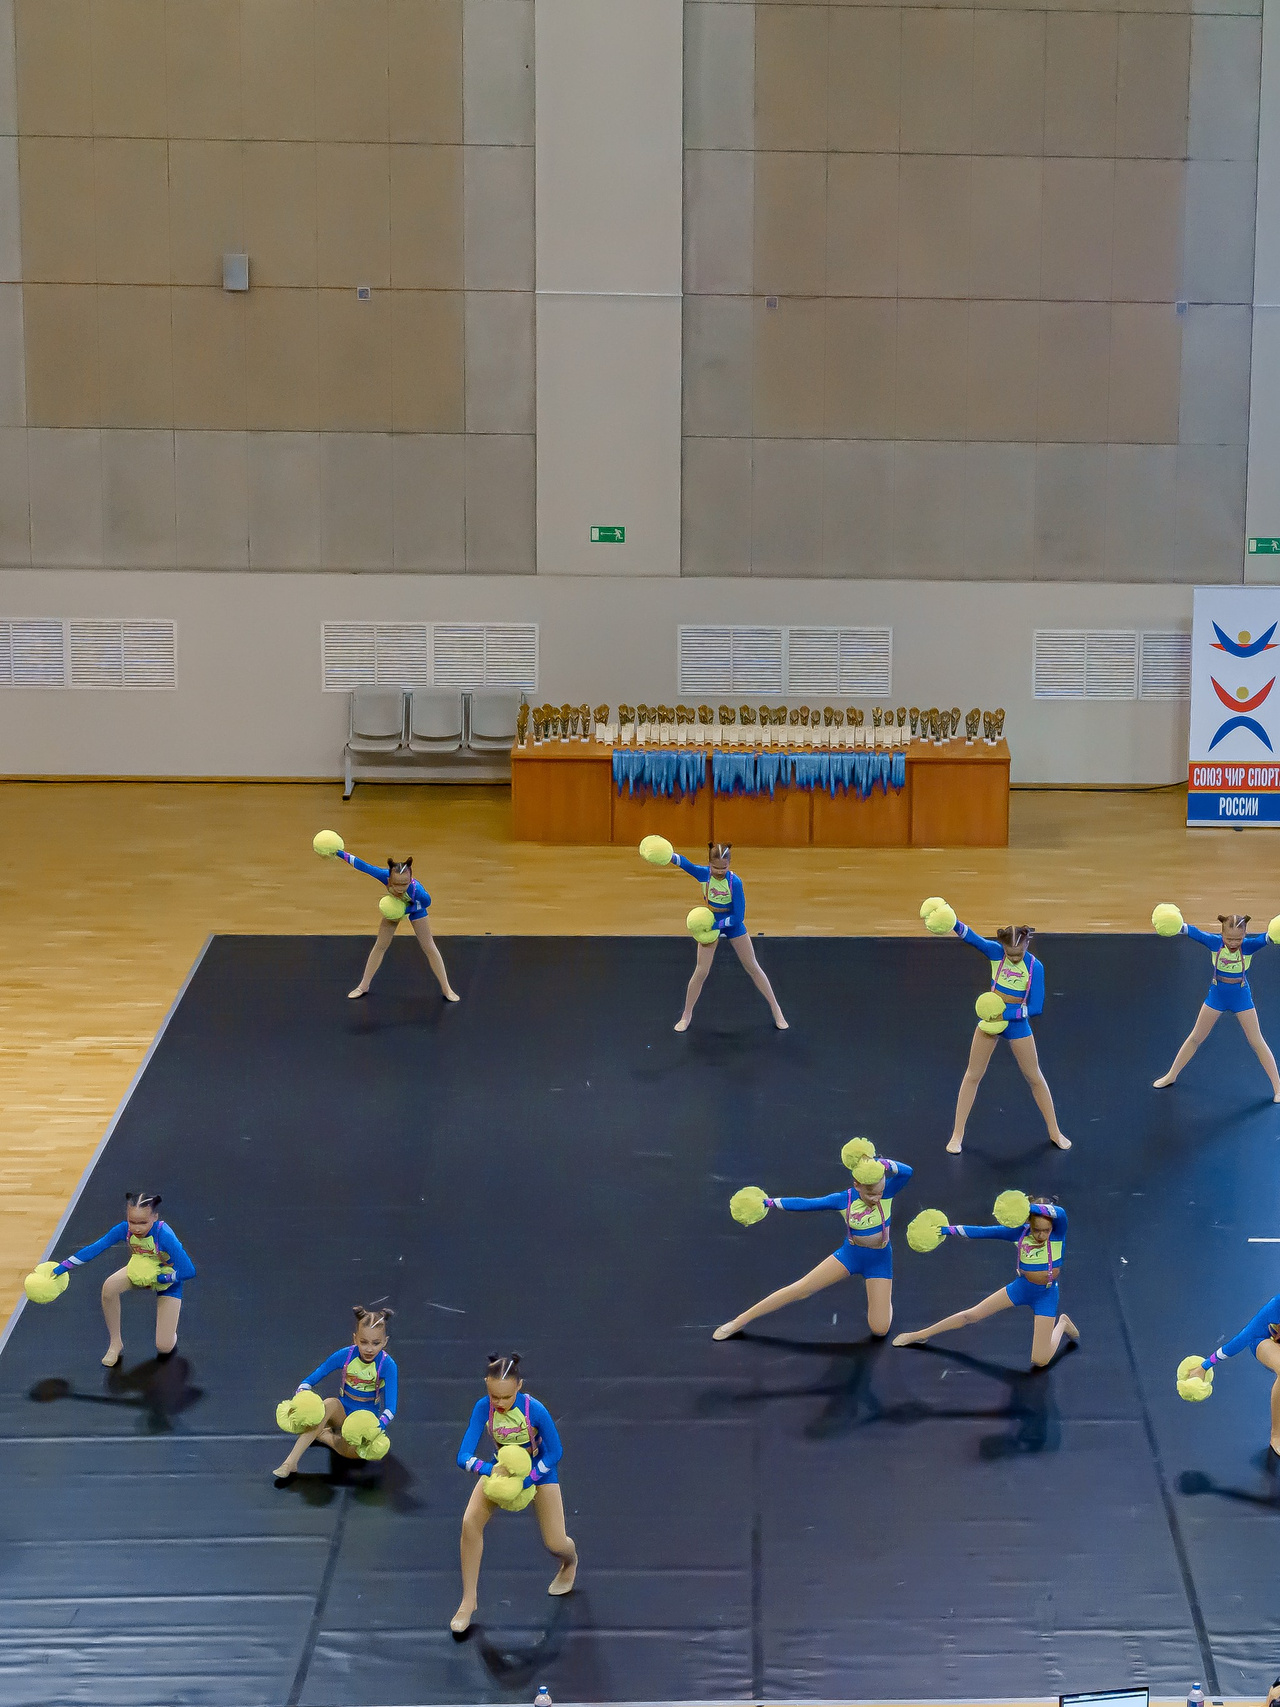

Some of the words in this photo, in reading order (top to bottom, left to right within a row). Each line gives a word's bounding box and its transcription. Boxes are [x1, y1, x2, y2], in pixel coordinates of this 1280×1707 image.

[1193, 767, 1222, 787] СОЮЗ
[1224, 766, 1246, 787] ЧИР
[1219, 796, 1259, 817] РОССИИ
